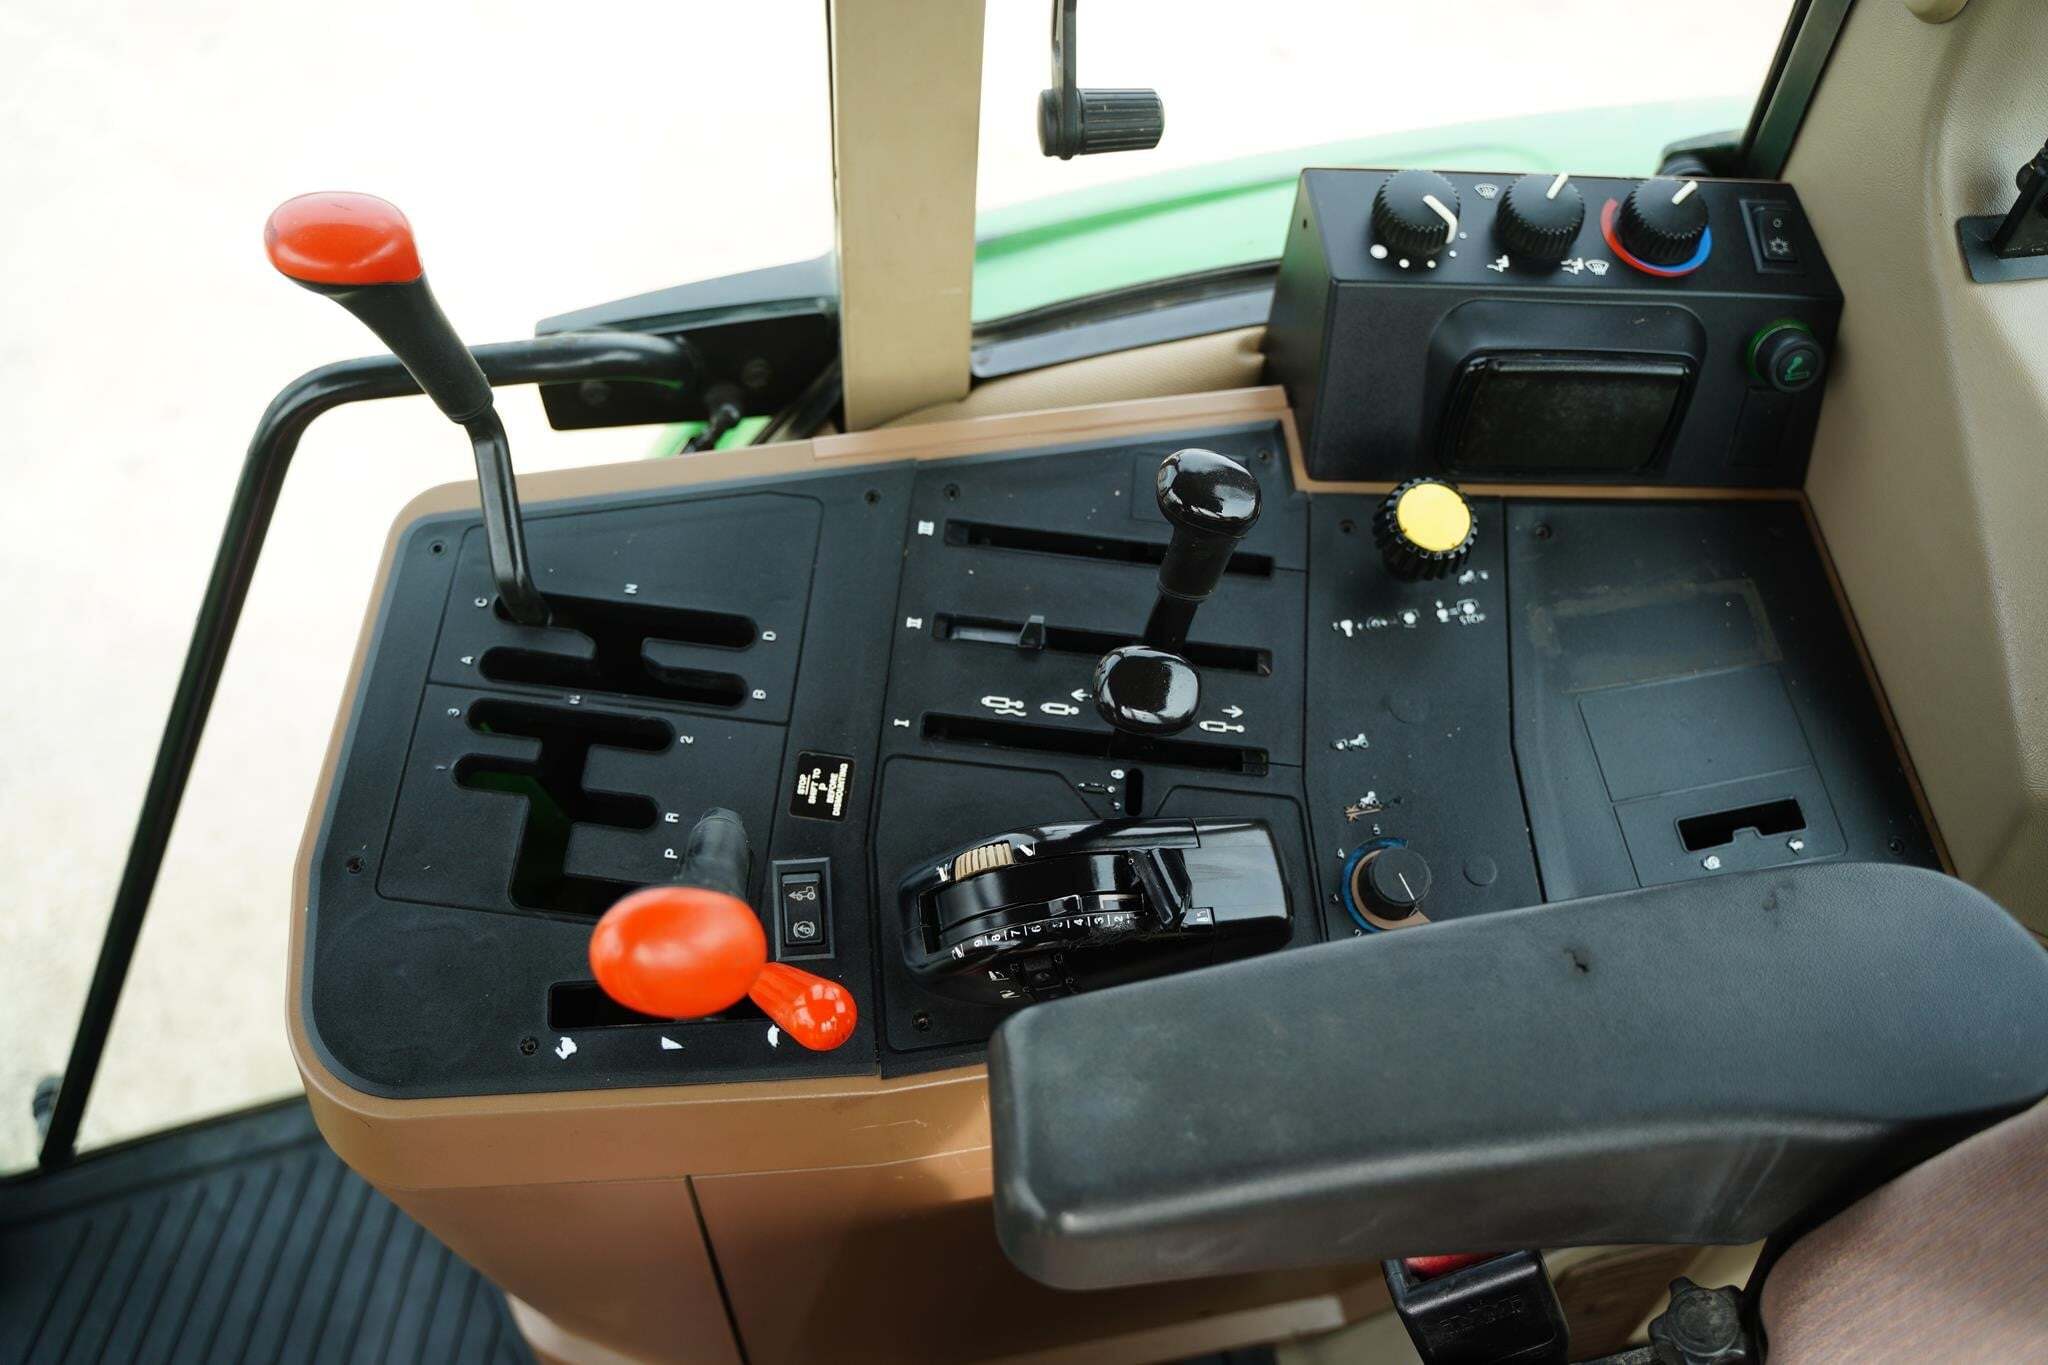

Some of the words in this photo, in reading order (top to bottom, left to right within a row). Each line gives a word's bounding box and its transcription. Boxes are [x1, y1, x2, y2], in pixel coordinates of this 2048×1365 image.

[624, 583, 638, 594] N
[475, 597, 487, 607] C
[906, 616, 922, 630] II
[762, 630, 776, 641] D
[460, 655, 474, 665] A
[752, 688, 766, 700] B
[448, 708, 460, 717] 3
[680, 735, 694, 745] 2
[812, 768, 821, 779] TO
[797, 774, 807, 795] STOP
[818, 783, 828, 791] P
[826, 773, 839, 803] BEFORE
[832, 763, 849, 816] DISMOUNTING
[808, 781, 819, 804] SHIFT
[664, 848, 678, 859] P
[1337, 848, 1345, 859] 4
[991, 932, 1000, 941] 8
[1031, 925, 1041, 933] 6
[1094, 917, 1104, 925] 3
